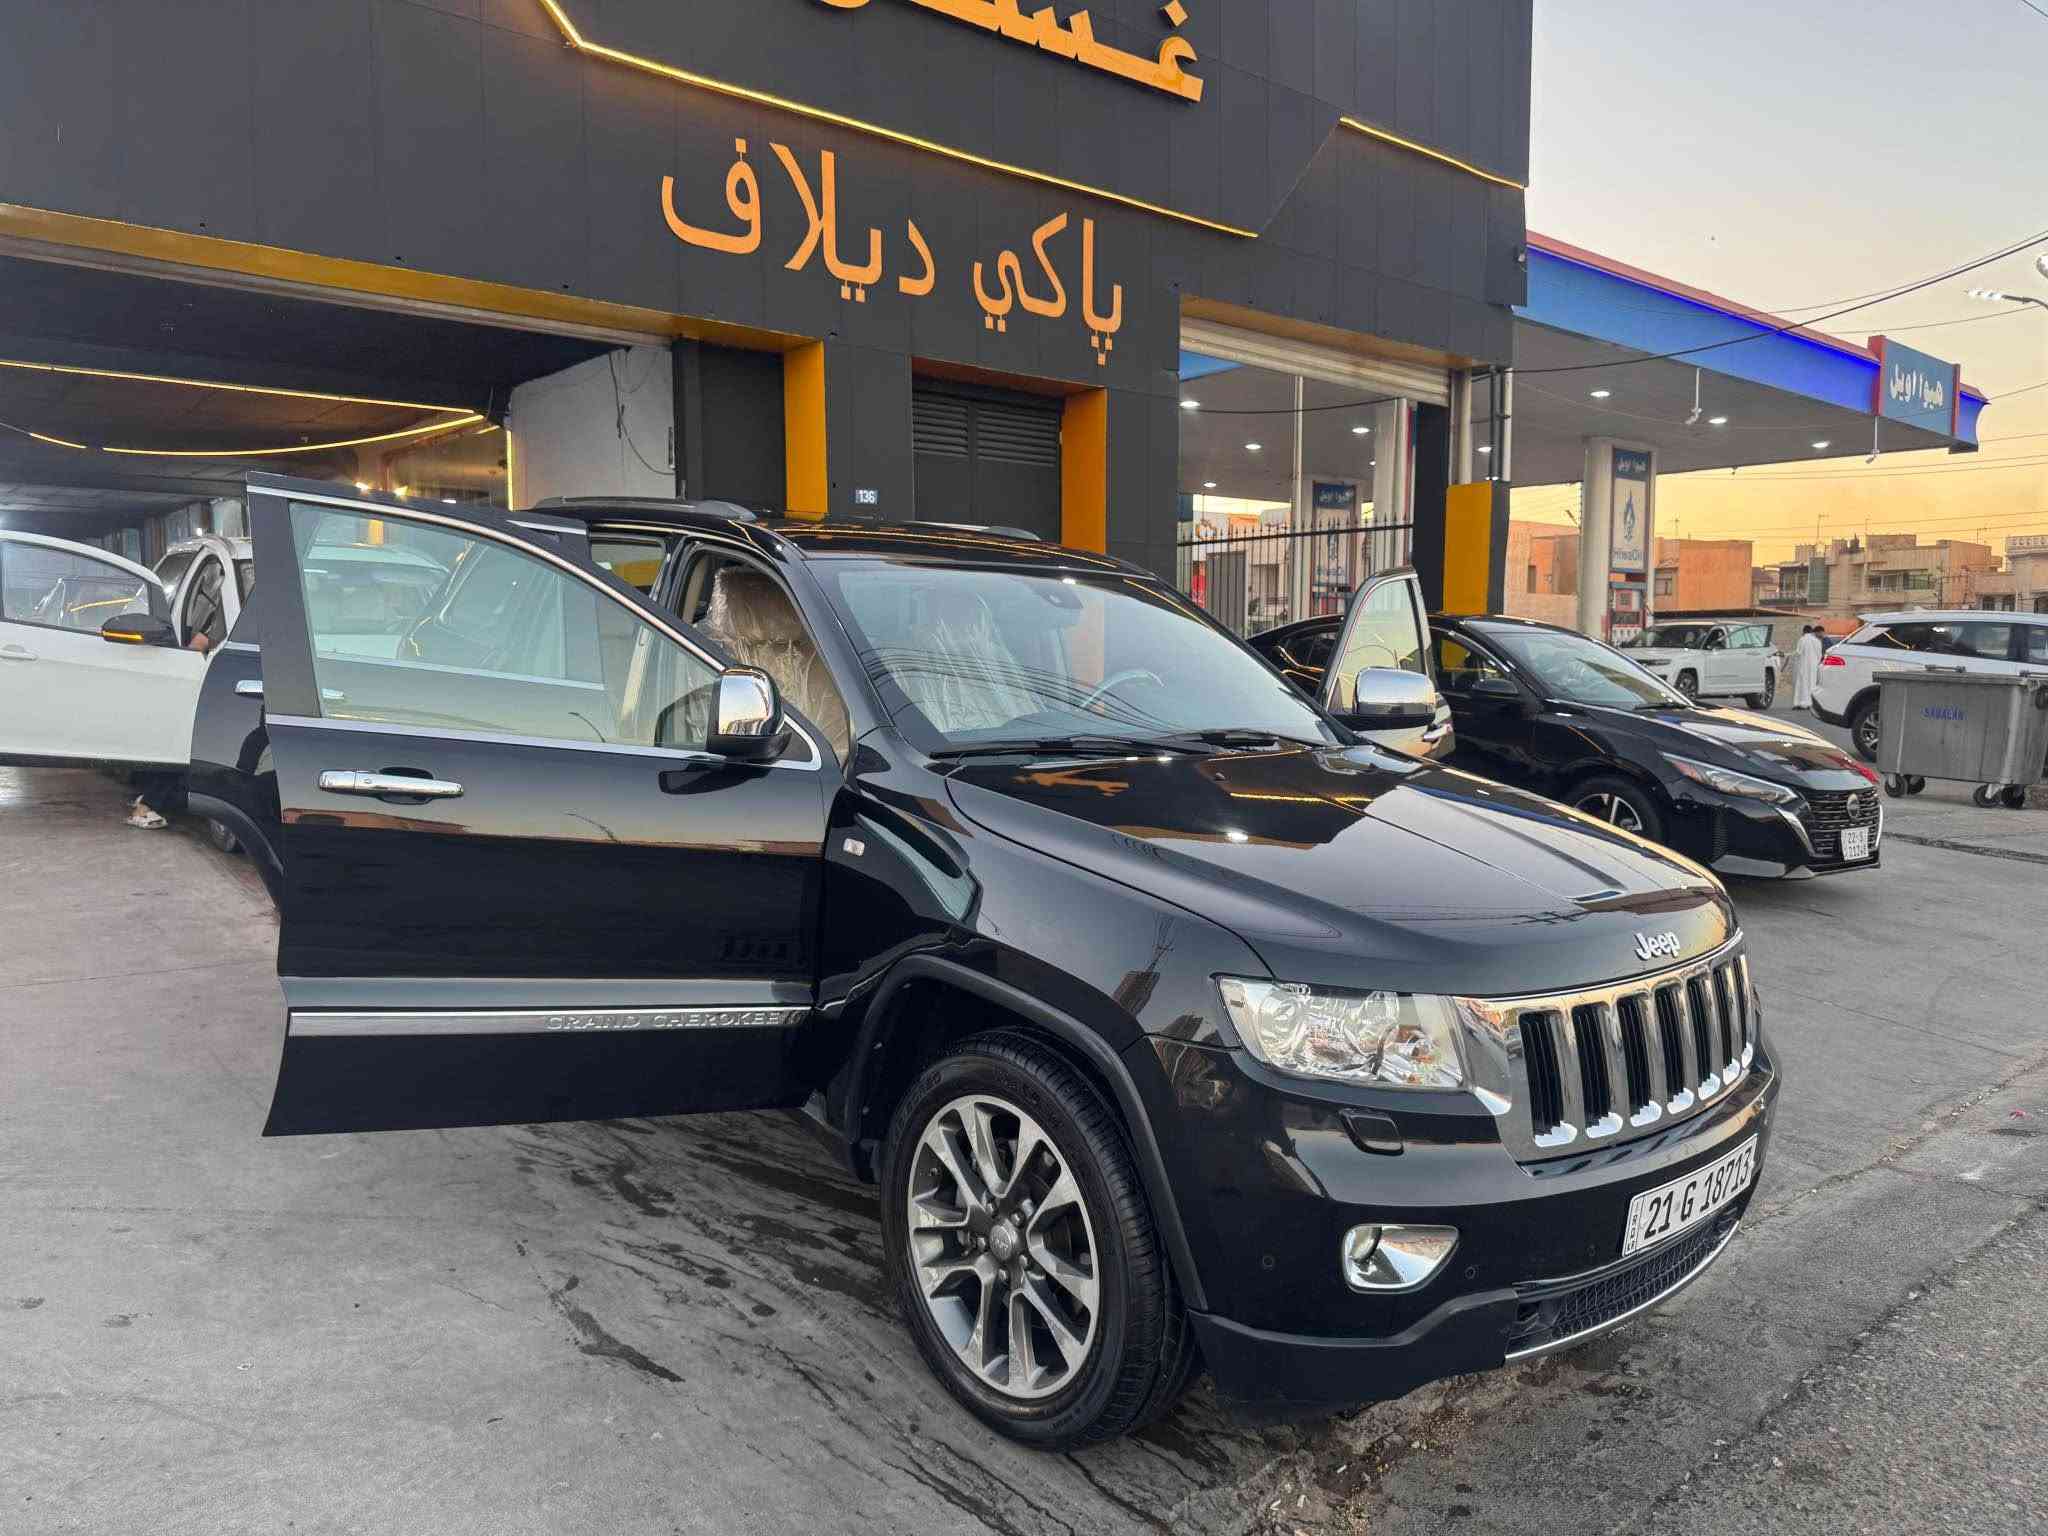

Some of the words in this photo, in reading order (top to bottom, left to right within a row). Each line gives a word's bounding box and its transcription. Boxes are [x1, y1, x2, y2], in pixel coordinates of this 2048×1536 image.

[820, 0, 1204, 102] غس
[858, 490, 876, 503] 136
[1634, 931, 1681, 960] Jeep
[547, 1014, 641, 1032] GRAND
[653, 1010, 782, 1029] CHEROKEE
[1644, 1190, 1674, 1240] 21
[1680, 1180, 1697, 1222] G
[1700, 1145, 1753, 1212] 18713
